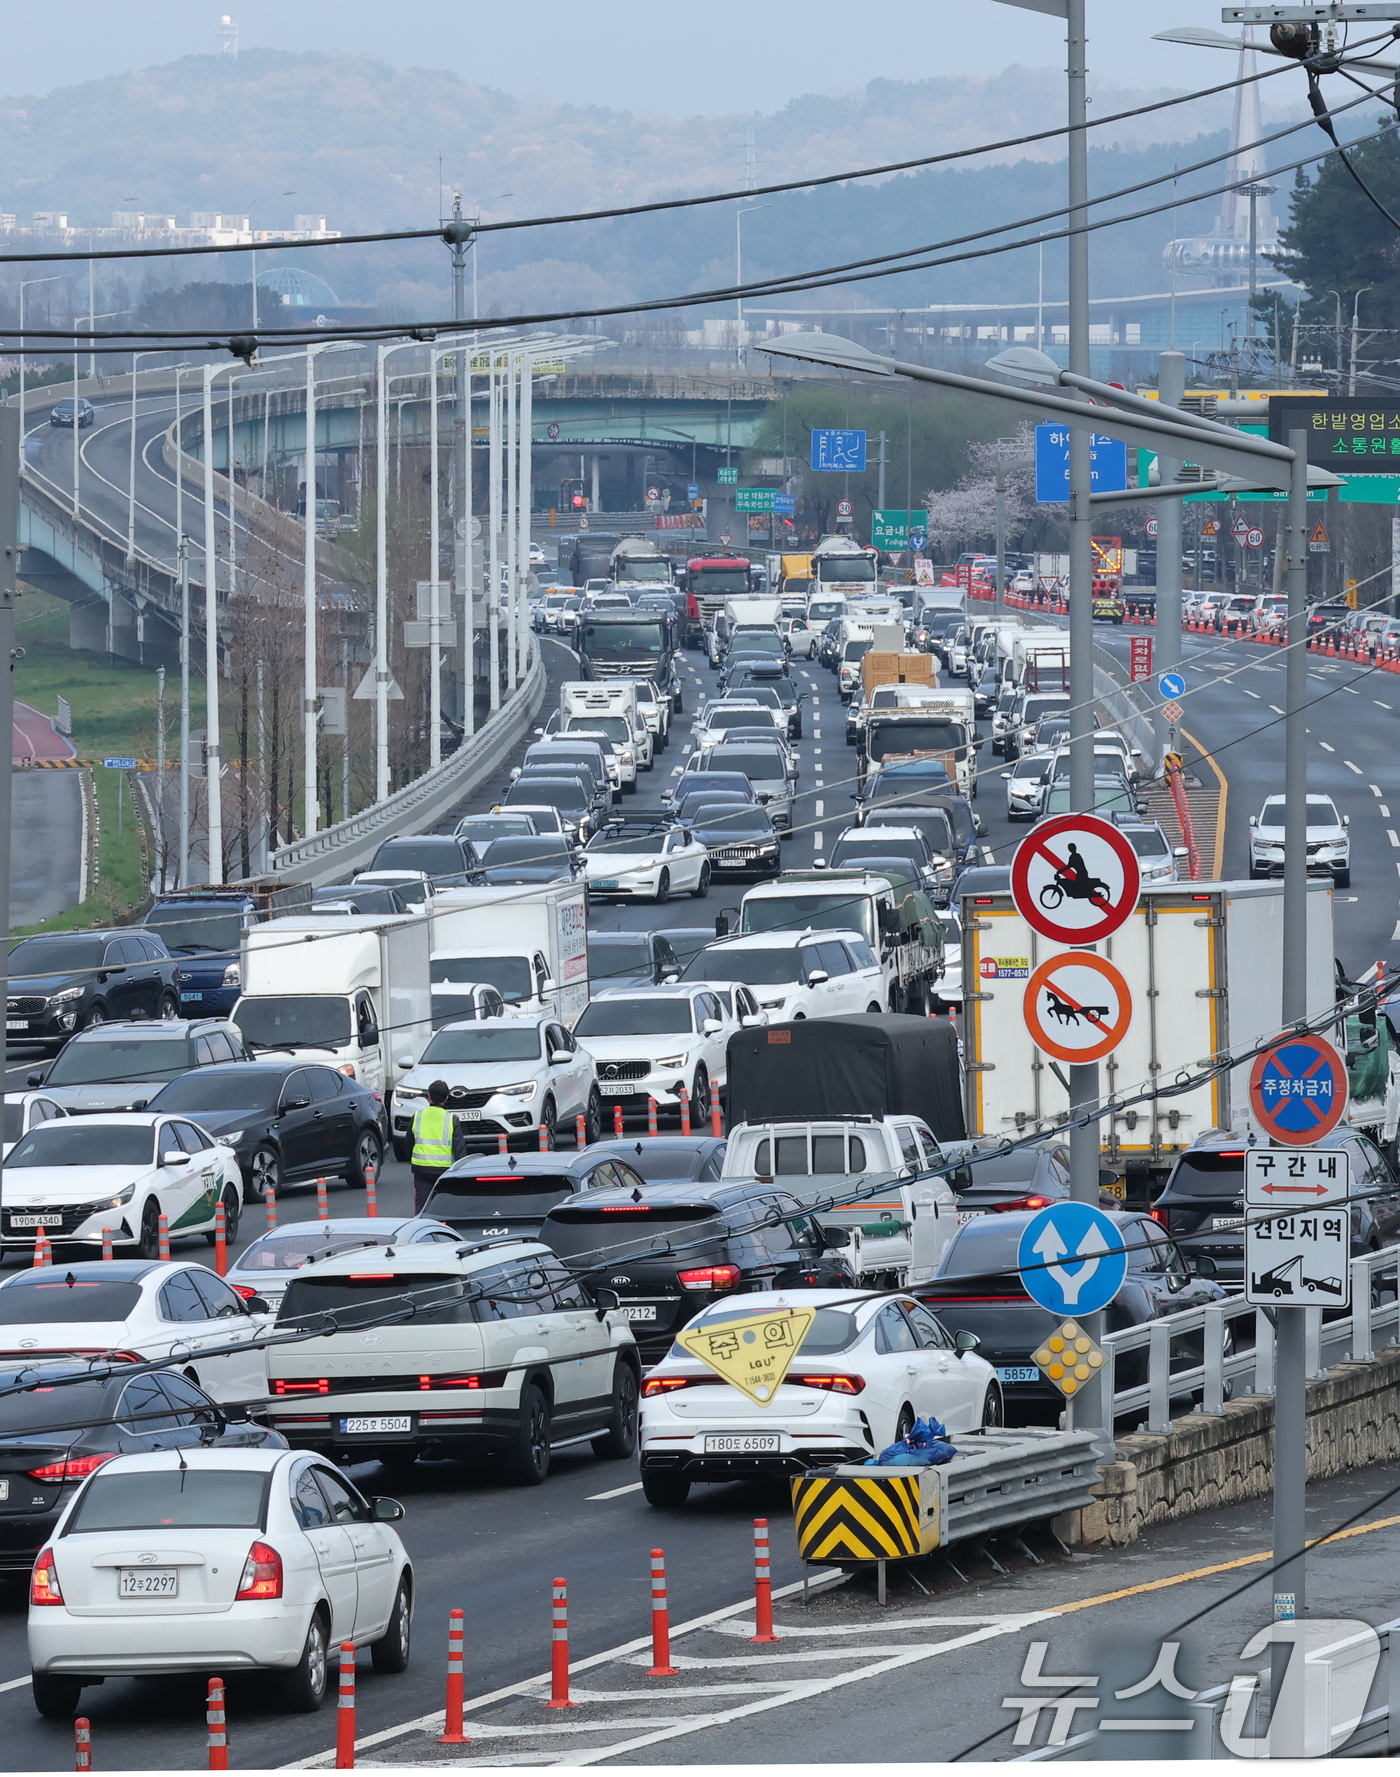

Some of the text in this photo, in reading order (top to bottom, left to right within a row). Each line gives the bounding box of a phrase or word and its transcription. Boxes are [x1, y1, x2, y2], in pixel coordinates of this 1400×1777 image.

[839, 503, 850, 513] 30
[1148, 522, 1158, 532] 60
[1250, 533, 1261, 543] 60
[998, 969, 1028, 978] 1577-0574
[183, 992, 199, 1000] 5041
[1264, 1079, 1332, 1096] 주정차금지
[37, 1215, 59, 1225] 4340
[1254, 1217, 1341, 1242] 견인지역
[613, 1277, 627, 1285] KIA
[623, 1308, 650, 1319] 0212
[708, 1320, 794, 1360] 주의
[306, 1359, 441, 1370] SANTA FE
[1004, 1368, 1033, 1379] 5857
[349, 1418, 408, 1431] 225호 5504
[711, 1437, 774, 1450] 180도 6509
